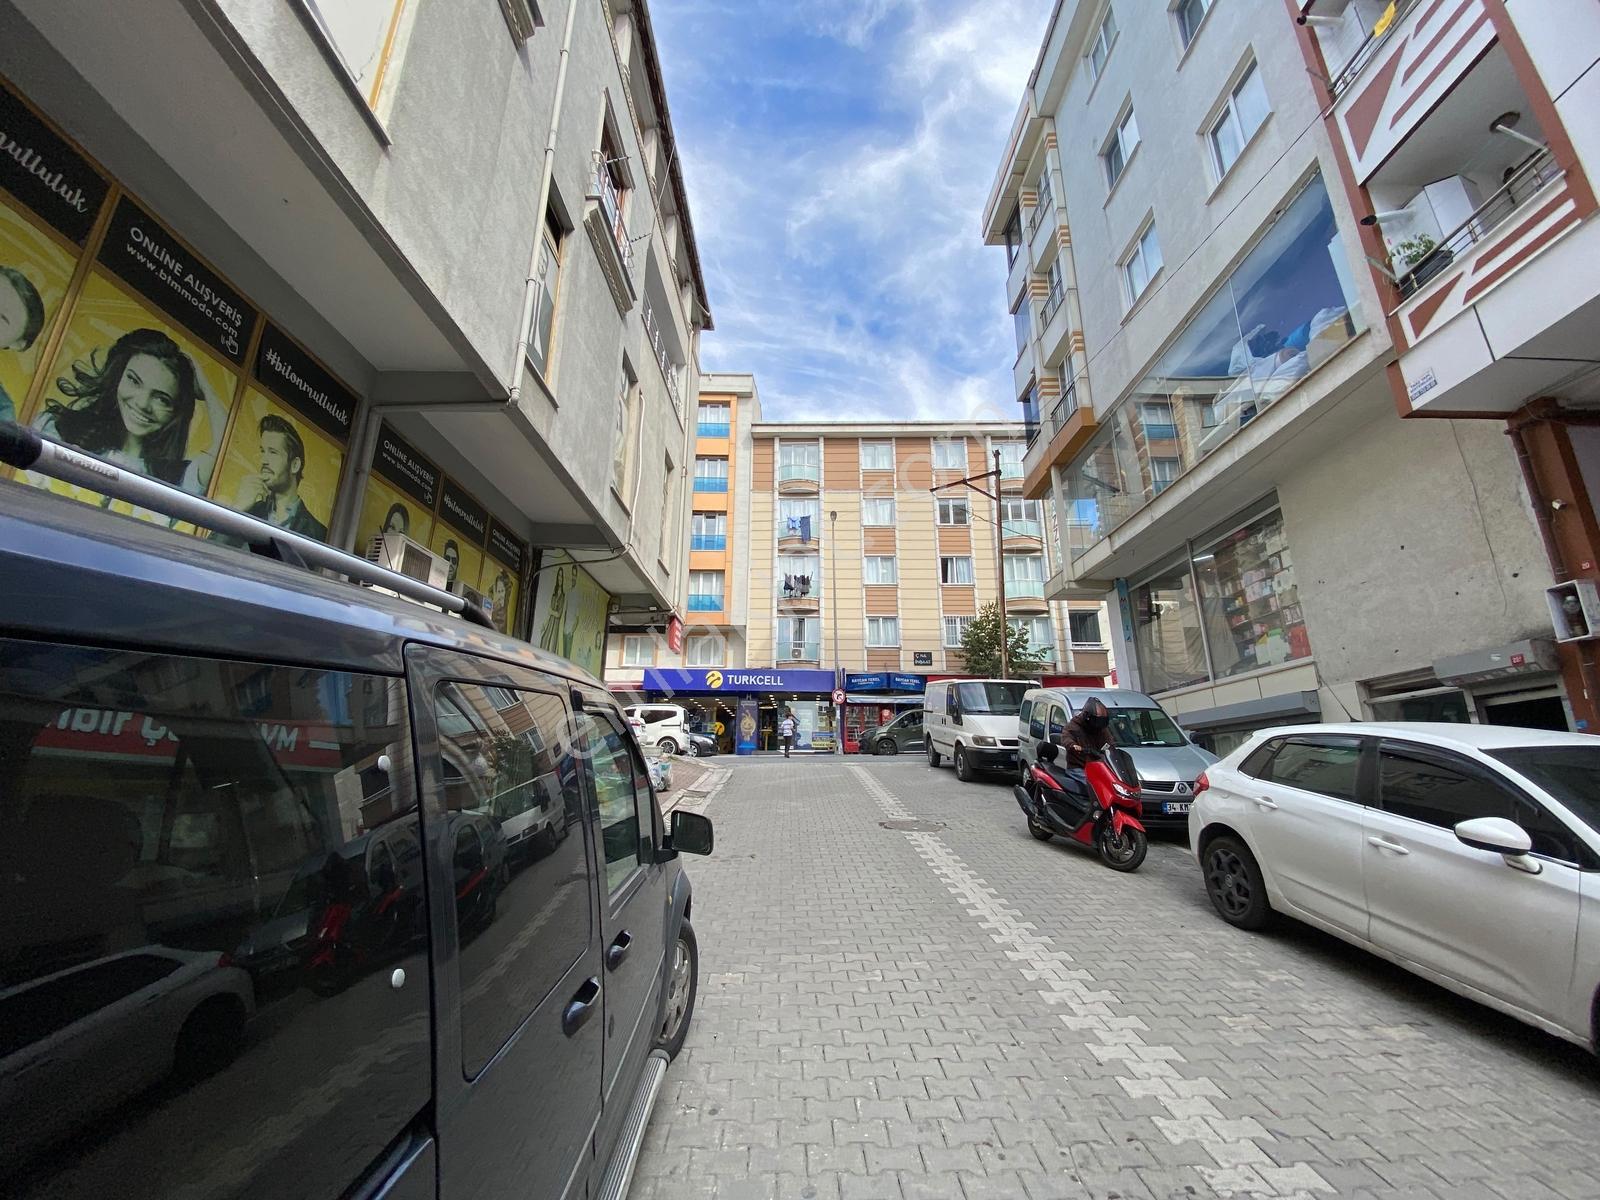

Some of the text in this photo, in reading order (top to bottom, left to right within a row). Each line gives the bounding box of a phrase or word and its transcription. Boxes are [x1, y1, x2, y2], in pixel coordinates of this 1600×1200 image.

[126, 244, 238, 338] www.btmmoda.com
[130, 227, 242, 327] ONLİNE ALIŞVERİŞ
[727, 674, 784, 686] TURKCELL
[1168, 803, 1177, 812] 34
